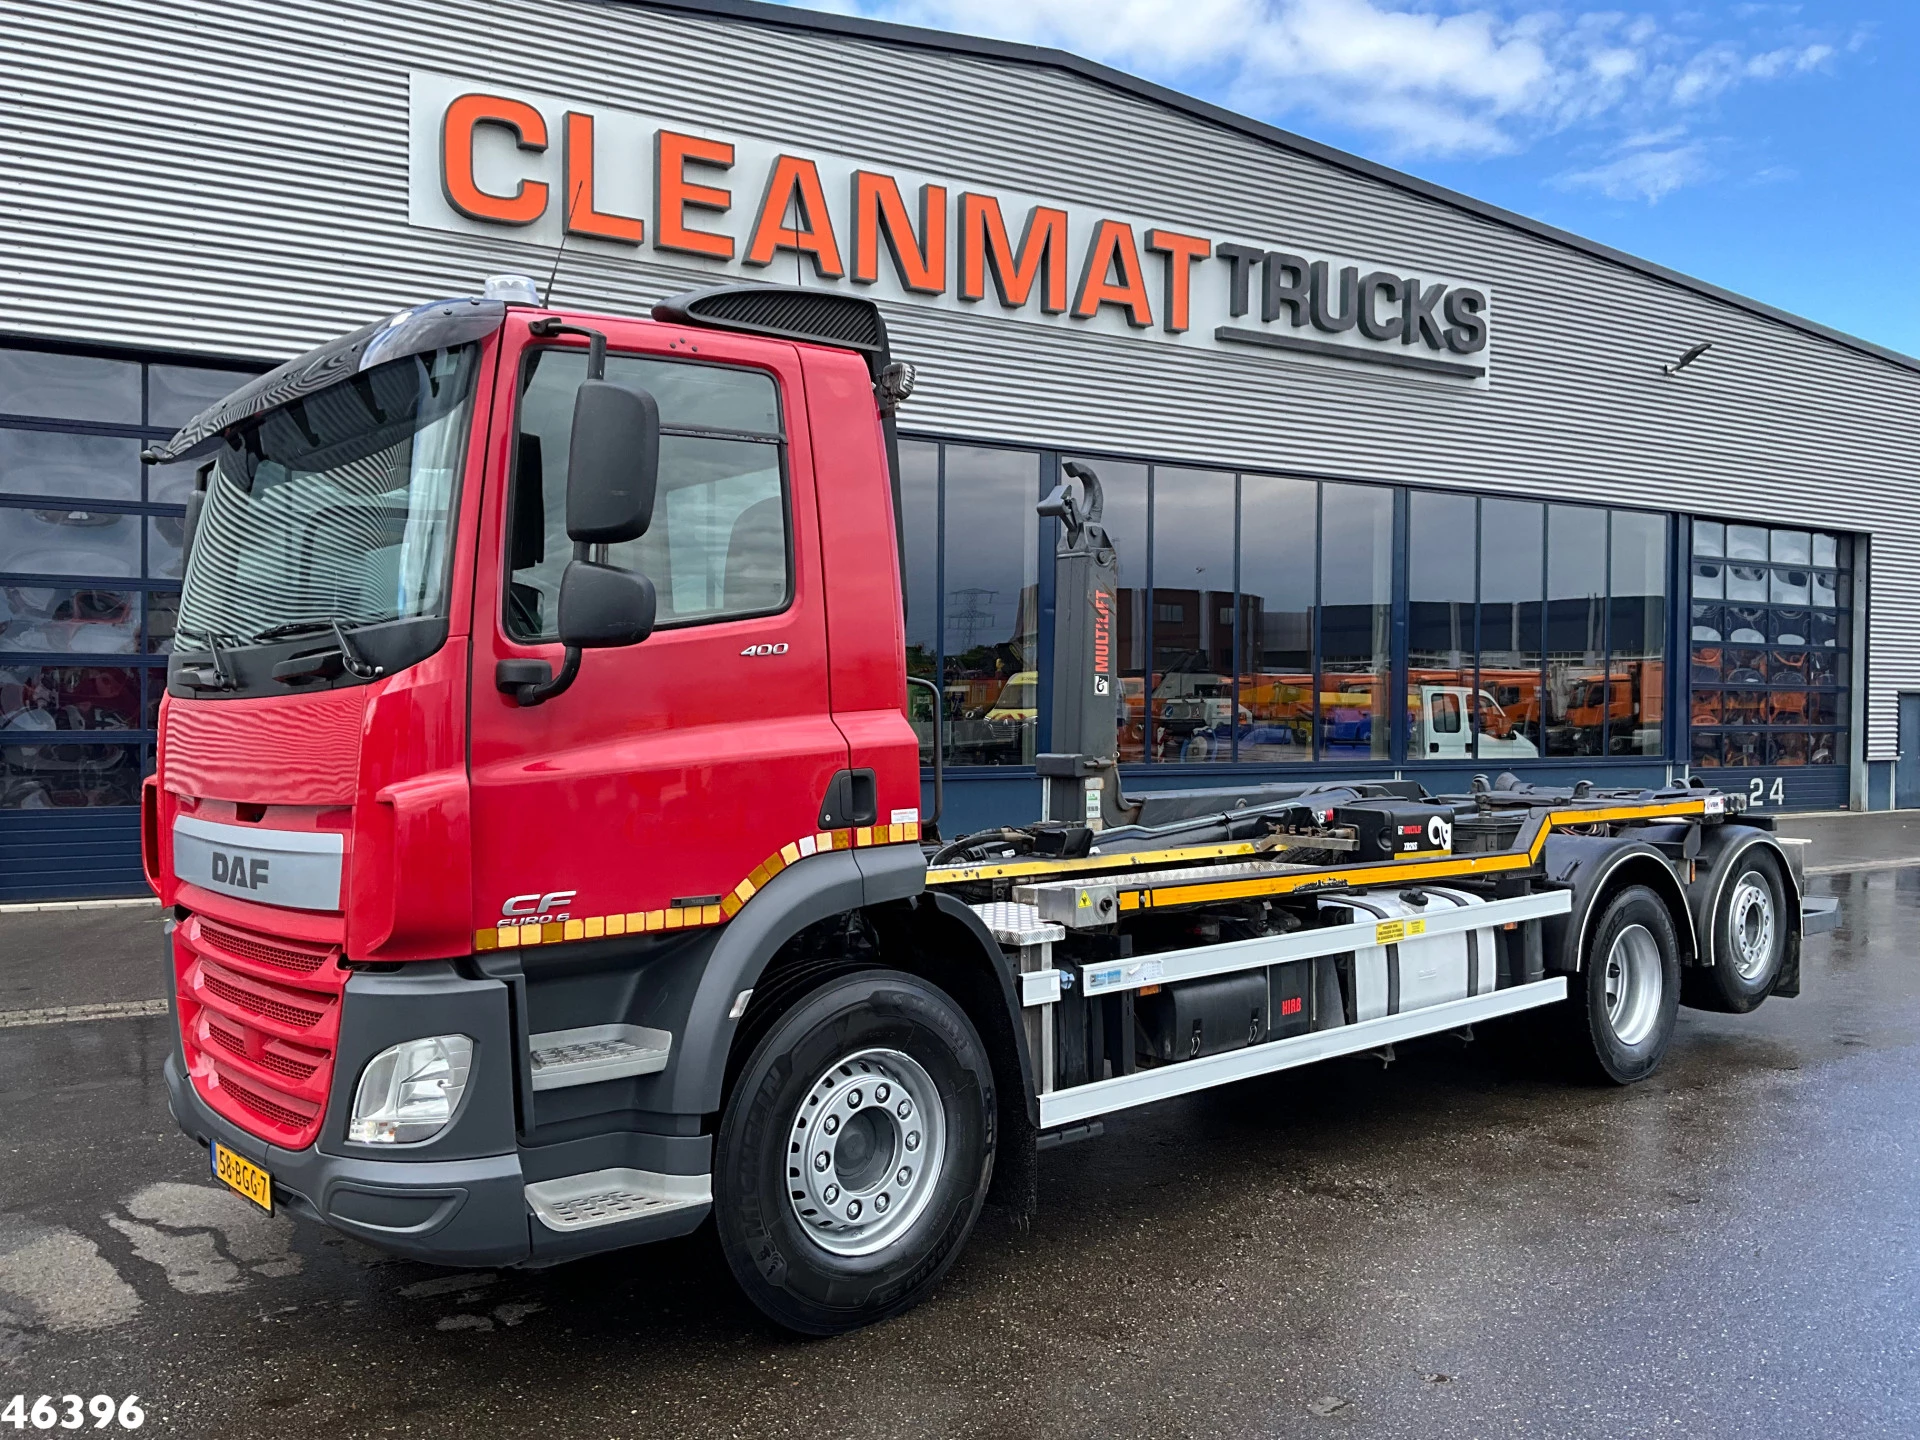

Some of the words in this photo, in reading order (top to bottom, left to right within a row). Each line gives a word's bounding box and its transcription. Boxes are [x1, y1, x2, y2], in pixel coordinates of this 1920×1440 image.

[442, 94, 1211, 333] CLEANMAT
[1217, 242, 1486, 353] TRUCKS
[1095, 589, 1109, 672] MULTILIFT
[740, 643, 789, 657] 400
[1749, 777, 1785, 807] 24
[211, 851, 270, 890] DAF
[501, 890, 577, 916] CF
[496, 914, 553, 928] EURO
[555, 912, 570, 922] 6
[1281, 997, 1302, 1016] HIAB
[219, 1149, 267, 1201] 58-BGG-7
